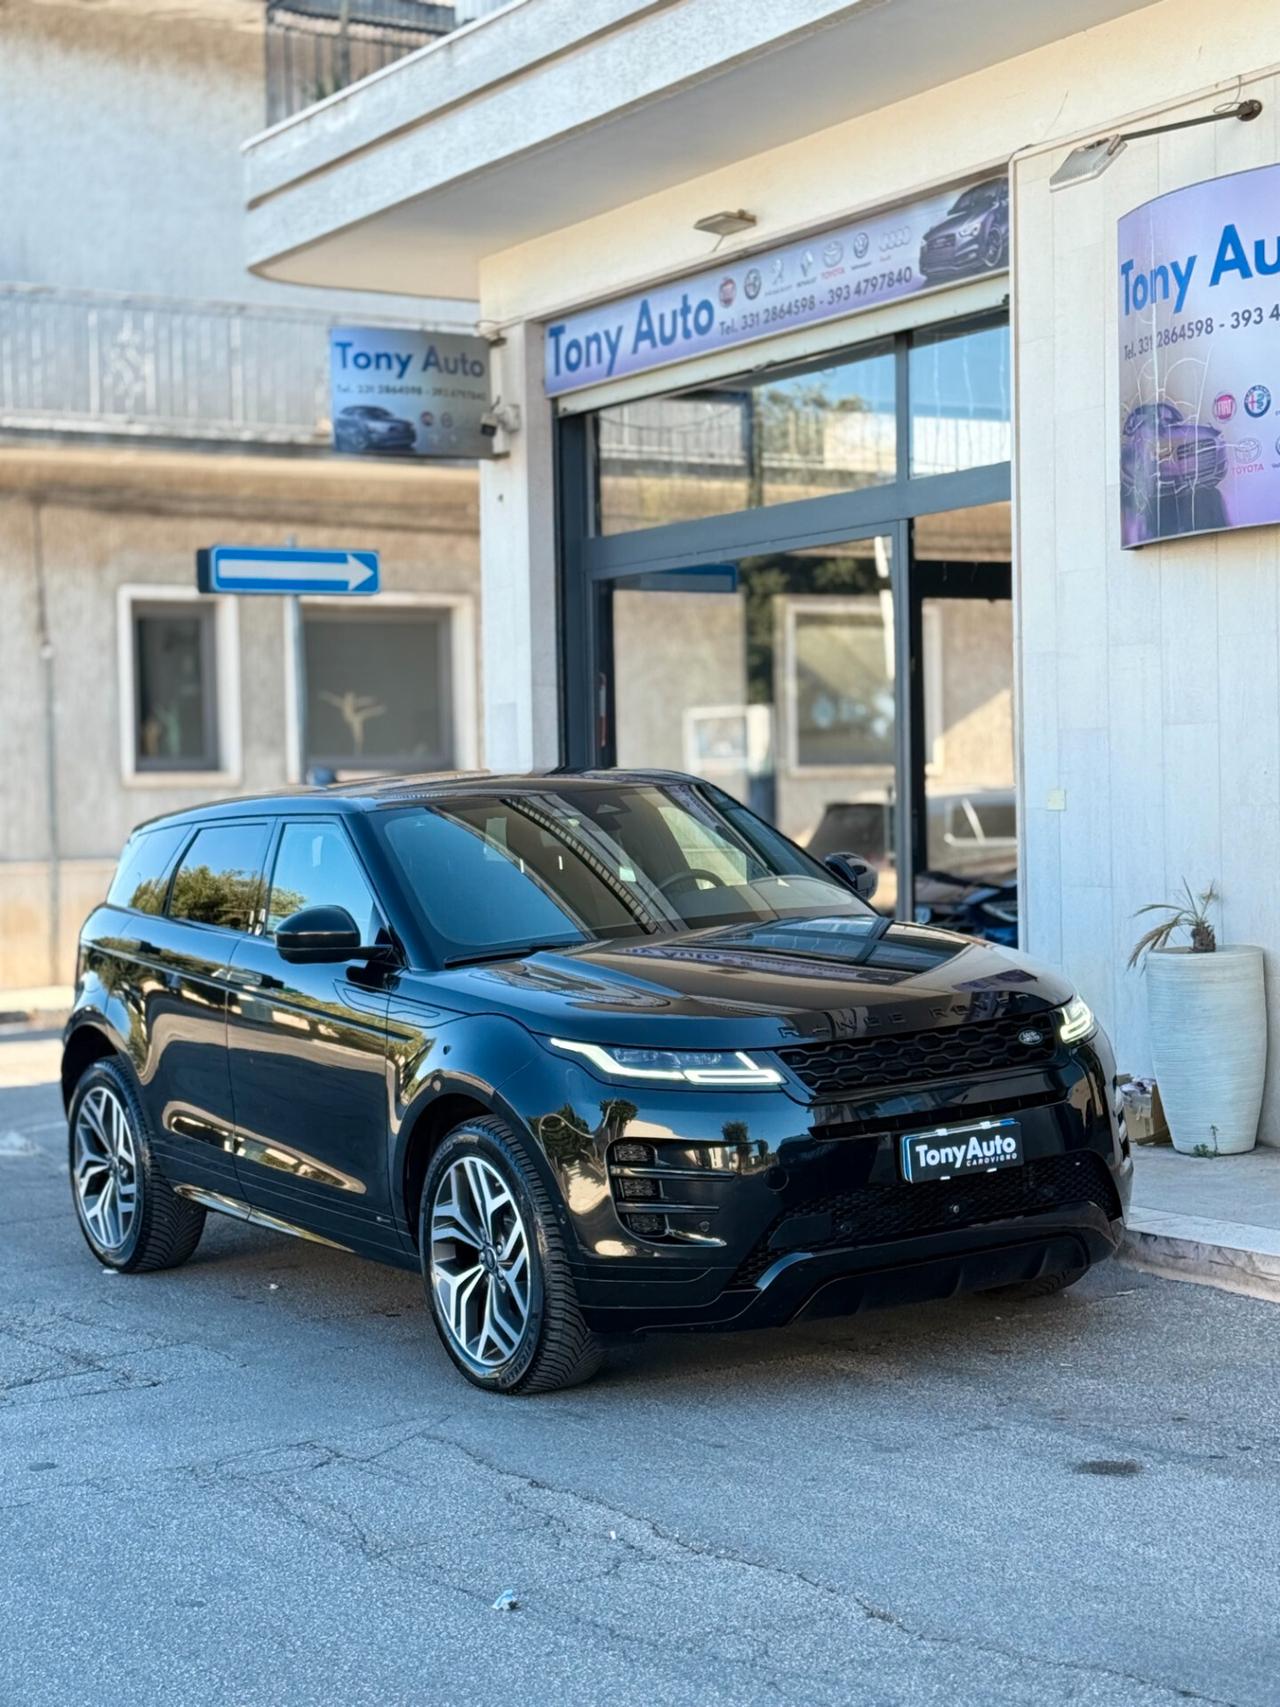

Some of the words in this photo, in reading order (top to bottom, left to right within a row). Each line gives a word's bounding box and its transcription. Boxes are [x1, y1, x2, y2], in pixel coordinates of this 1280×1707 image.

[1120, 254, 1198, 316] Tony
[1209, 223, 1280, 288] Au
[719, 318, 739, 336] Tel.
[741, 312, 760, 330] 331
[763, 294, 816, 324] 2864598
[827, 284, 851, 305] 393
[854, 266, 912, 296] 4797840
[548, 324, 623, 377] Tony
[632, 294, 714, 354] Auto
[1156, 317, 1214, 348] 2864598
[1230, 306, 1264, 329] 393
[335, 342, 413, 379] Tony
[421, 345, 486, 378] Auto
[1231, 463, 1264, 475] TOYOTA
[915, 1135, 1016, 1168] TonyAuto
